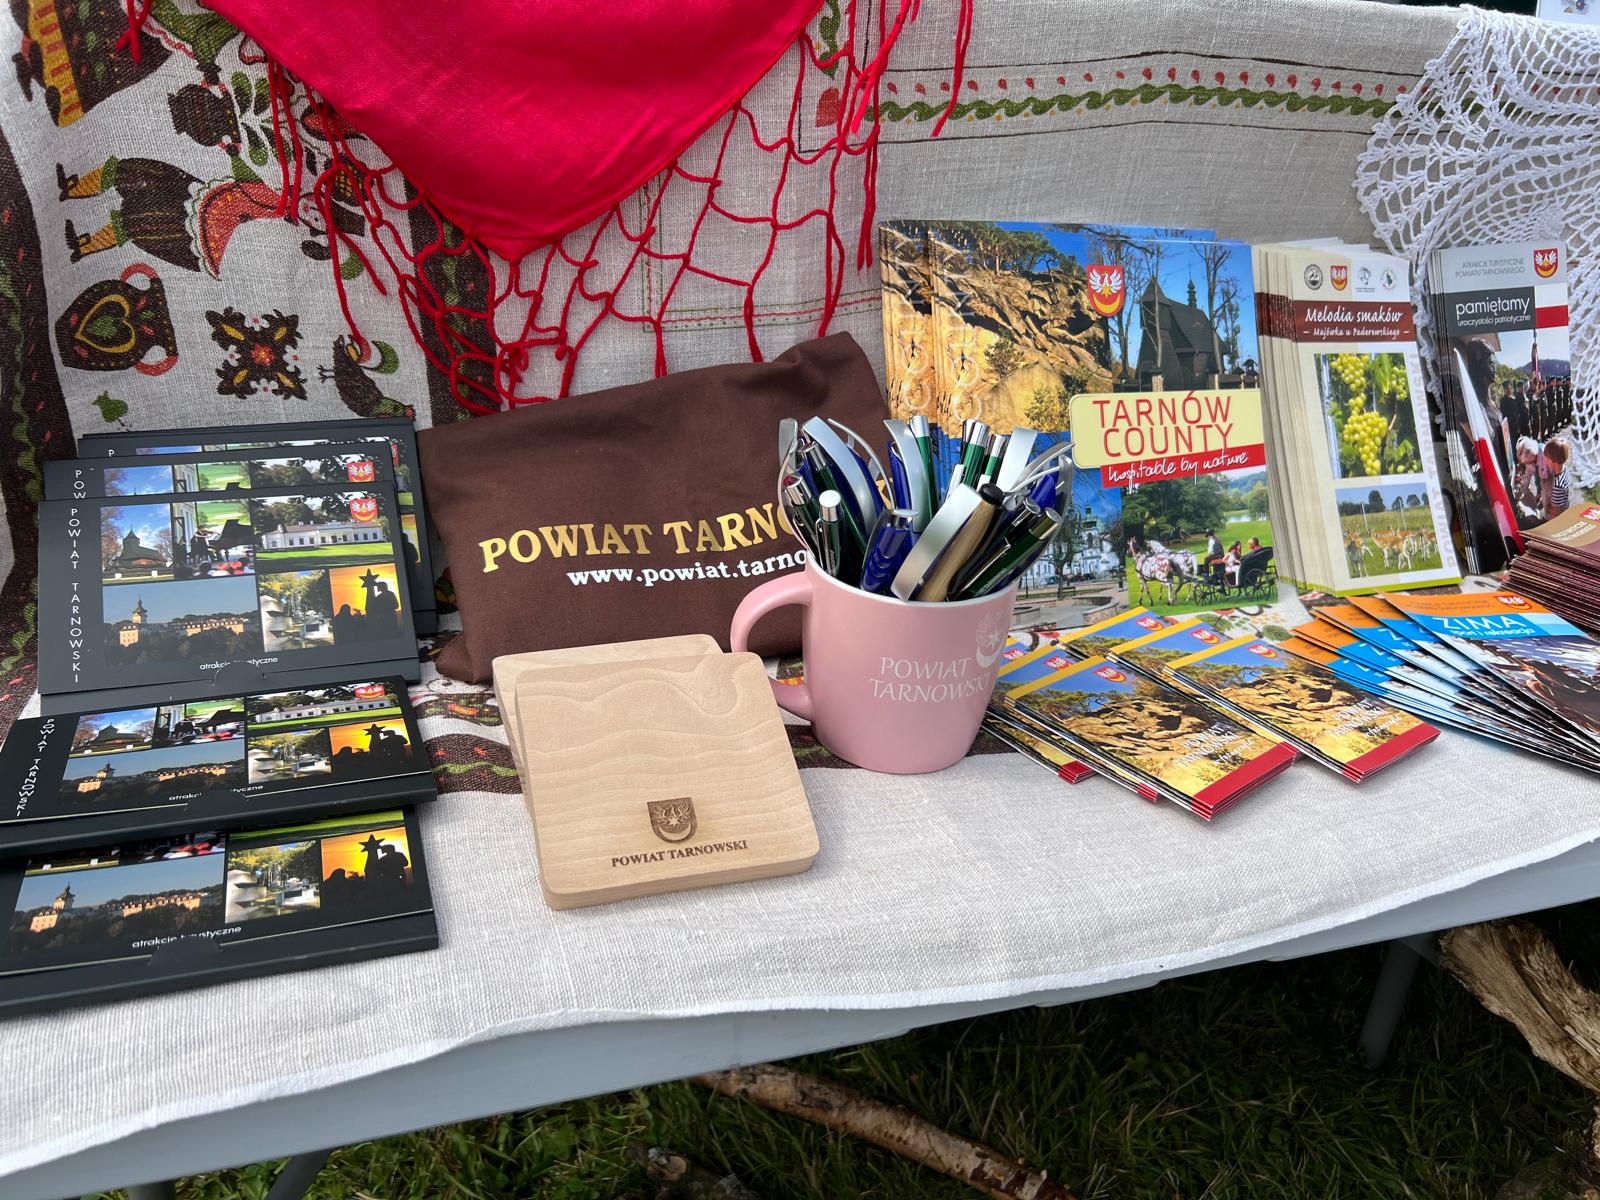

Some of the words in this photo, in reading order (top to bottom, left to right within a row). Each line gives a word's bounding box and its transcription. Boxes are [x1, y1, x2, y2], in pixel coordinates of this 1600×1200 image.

[1455, 269, 1481, 278] POWIATU
[1482, 266, 1525, 277] TARNOWSKIEGO
[1488, 257, 1524, 268] TURYSTYCZNE
[1305, 305, 1354, 323] Melodia
[1356, 305, 1404, 323] smaków
[1455, 297, 1530, 320] pamiętamy
[1457, 317, 1494, 327] uroczystości
[1494, 314, 1531, 325] patriotyczne
[1353, 326, 1400, 340] Paderewskiego
[1093, 389, 1232, 428] TARNÓW
[1103, 423, 1233, 457] COUNTY
[1108, 458, 1177, 495] hospitable
[1180, 457, 1198, 486] by
[1203, 449, 1248, 469] nature
[67, 508, 82, 570] POWIAT
[479, 522, 652, 574] POWIAT
[68, 582, 85, 683] TARNOWSKI
[1431, 616, 1527, 630] ZIMA
[879, 656, 972, 680] POWIAT
[869, 671, 991, 703] TARNOWSKI
[1332, 698, 1374, 722] POWIAT
[37, 718, 55, 753] POWIAT
[1173, 730, 1239, 768] TARNOWSKI
[1180, 723, 1225, 750] POWIAT
[16, 758, 41, 817] TARNOWSKI
[611, 850, 666, 868] POWIAT
[667, 839, 749, 860] TARNOWSKI
